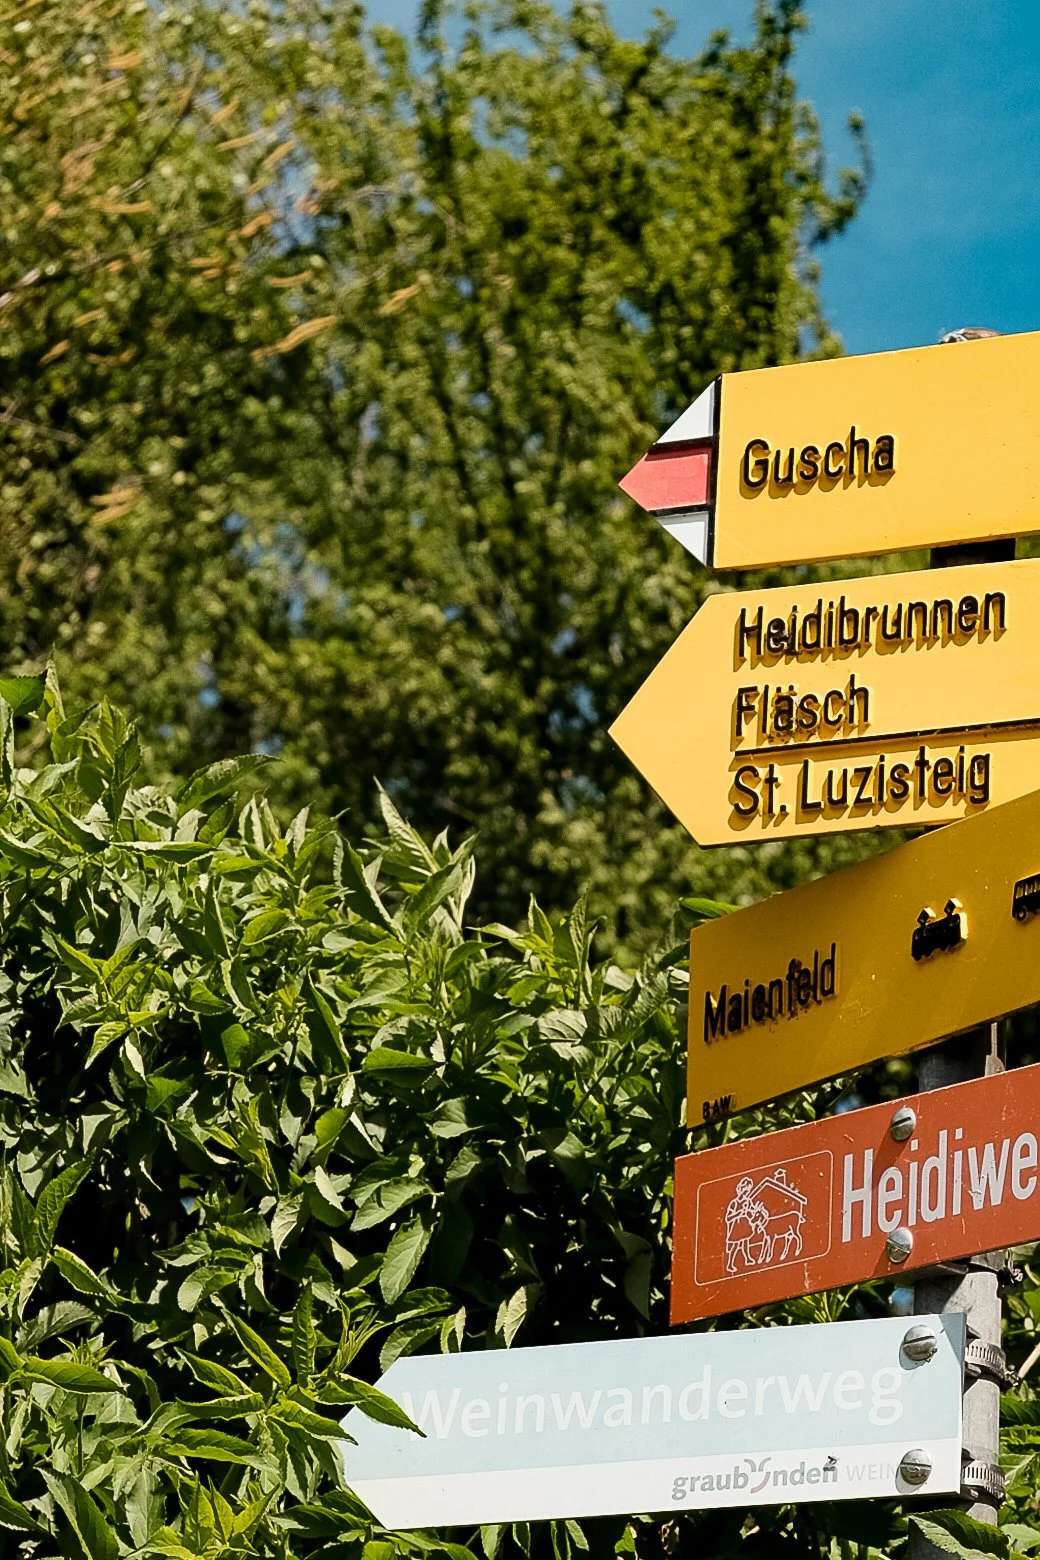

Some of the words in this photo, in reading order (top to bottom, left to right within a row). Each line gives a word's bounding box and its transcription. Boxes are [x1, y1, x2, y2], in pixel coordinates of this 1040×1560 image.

[740, 426, 896, 488] Guscha
[737, 591, 1007, 658] Heidibrunnen
[734, 675, 870, 738] Fläsch
[732, 766, 788, 817] St.
[798, 747, 992, 812] Luzisteig
[703, 943, 837, 1043] Maienfeld
[702, 1094, 732, 1119] BAW
[401, 1364, 904, 1442] Weinwanderweg
